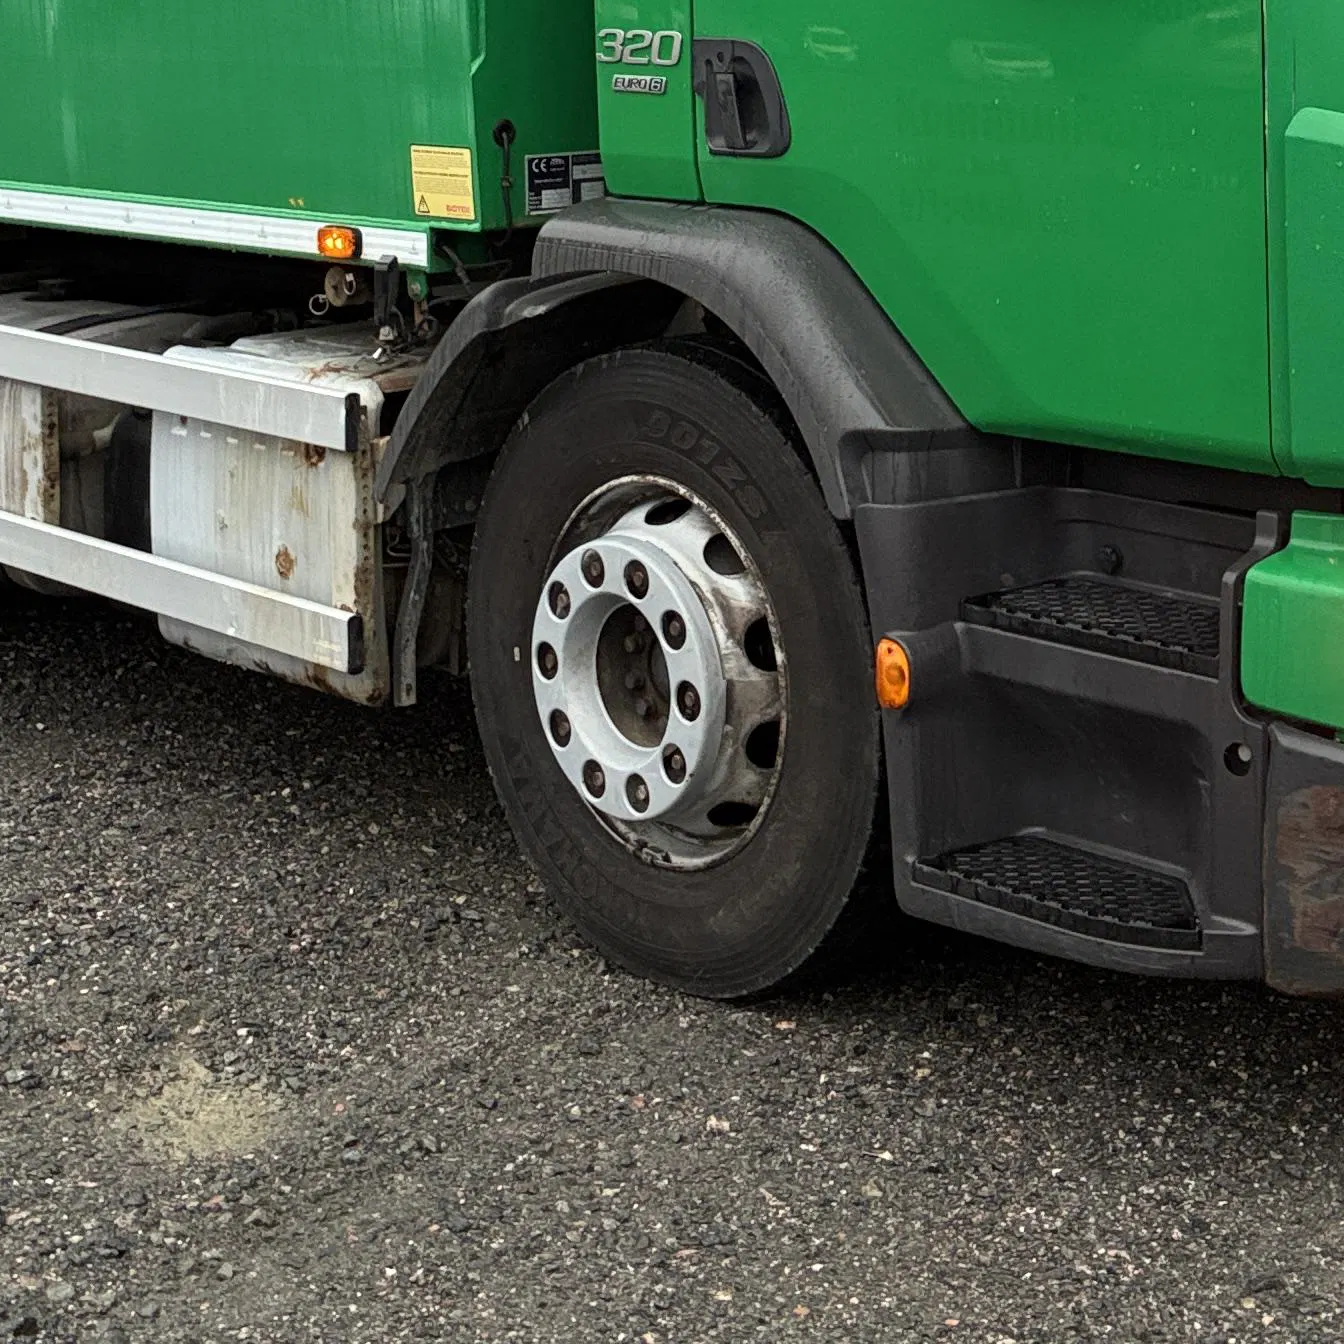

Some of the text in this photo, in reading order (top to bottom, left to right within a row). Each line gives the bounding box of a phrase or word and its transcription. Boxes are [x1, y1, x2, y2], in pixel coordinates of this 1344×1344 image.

[596, 29, 682, 66] 320
[614, 77, 647, 89] EURO
[532, 158, 547, 173] CE
